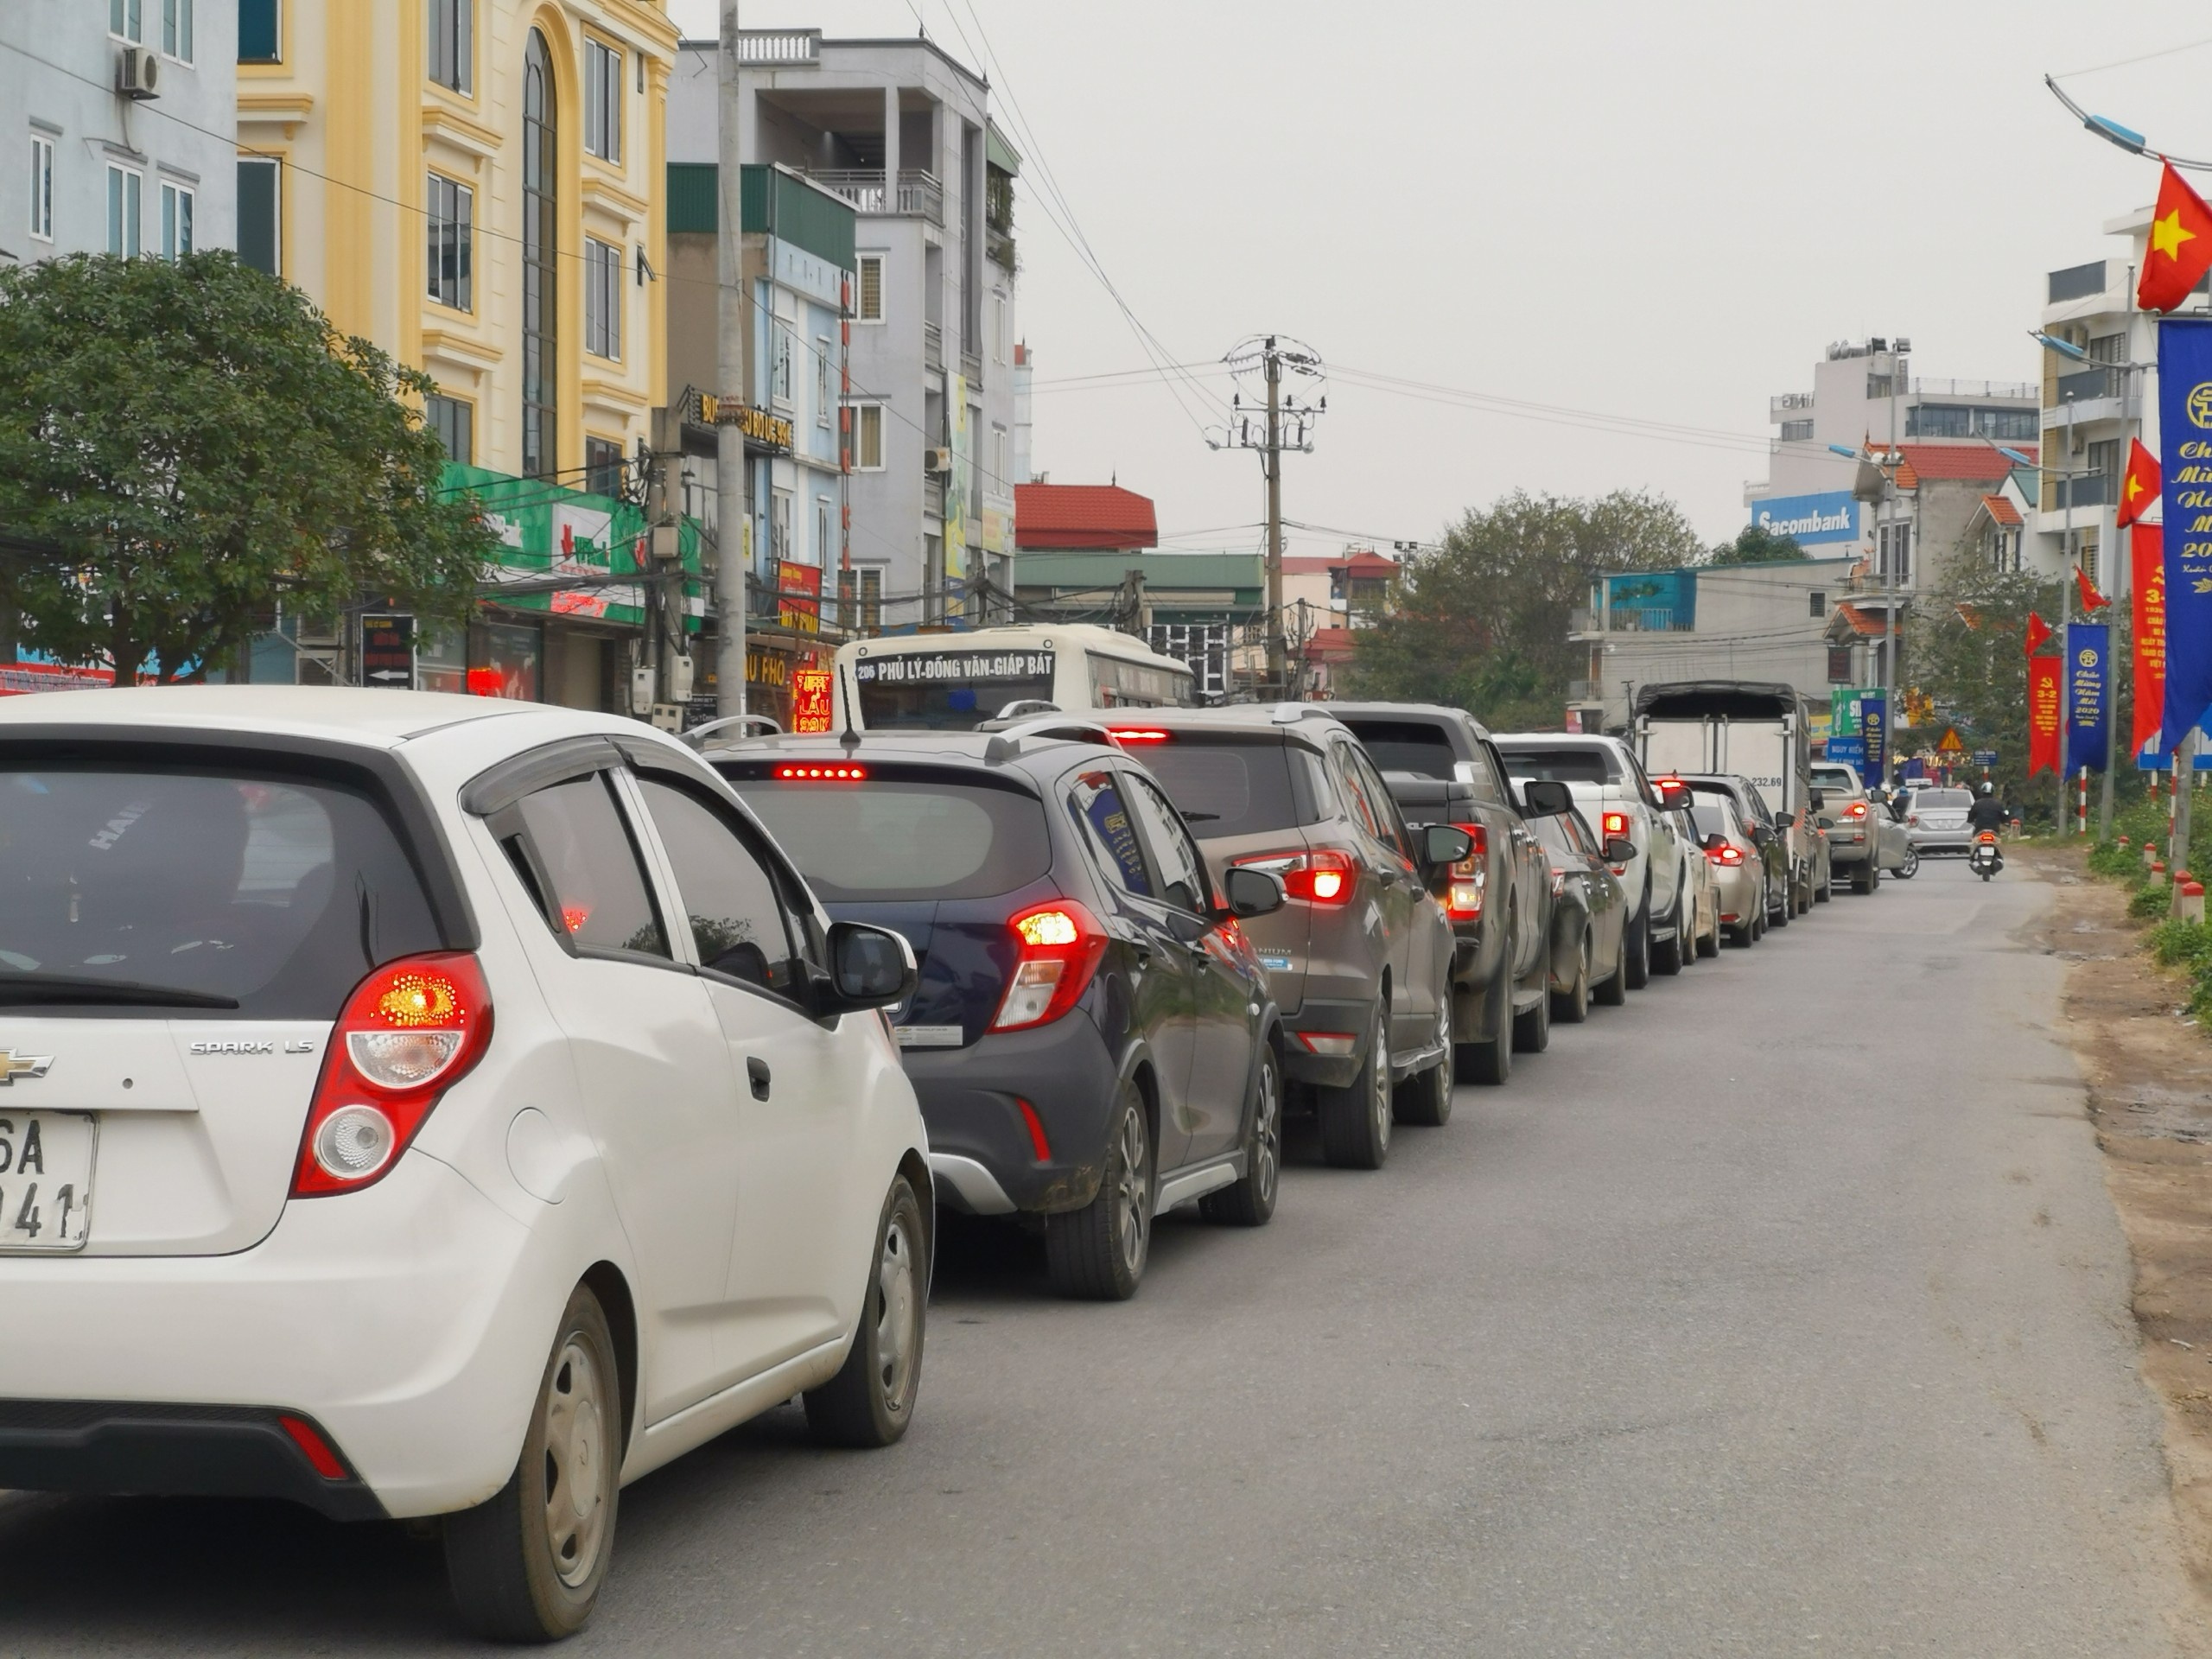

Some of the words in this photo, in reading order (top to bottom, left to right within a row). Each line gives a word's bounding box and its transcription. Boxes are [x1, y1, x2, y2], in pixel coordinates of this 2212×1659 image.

[1759, 506, 1850, 536] Sacombank
[2179, 542, 2212, 558] 20
[858, 664, 875, 680] 206
[879, 655, 905, 681] PHỦ
[1027, 652, 1052, 675] BÁT
[2037, 690, 2057, 698] 3-2
[1751, 777, 1782, 787] 232.69
[190, 1041, 274, 1055] SPARK
[284, 1039, 313, 1054] LS
[0, 1182, 74, 1237] 41
